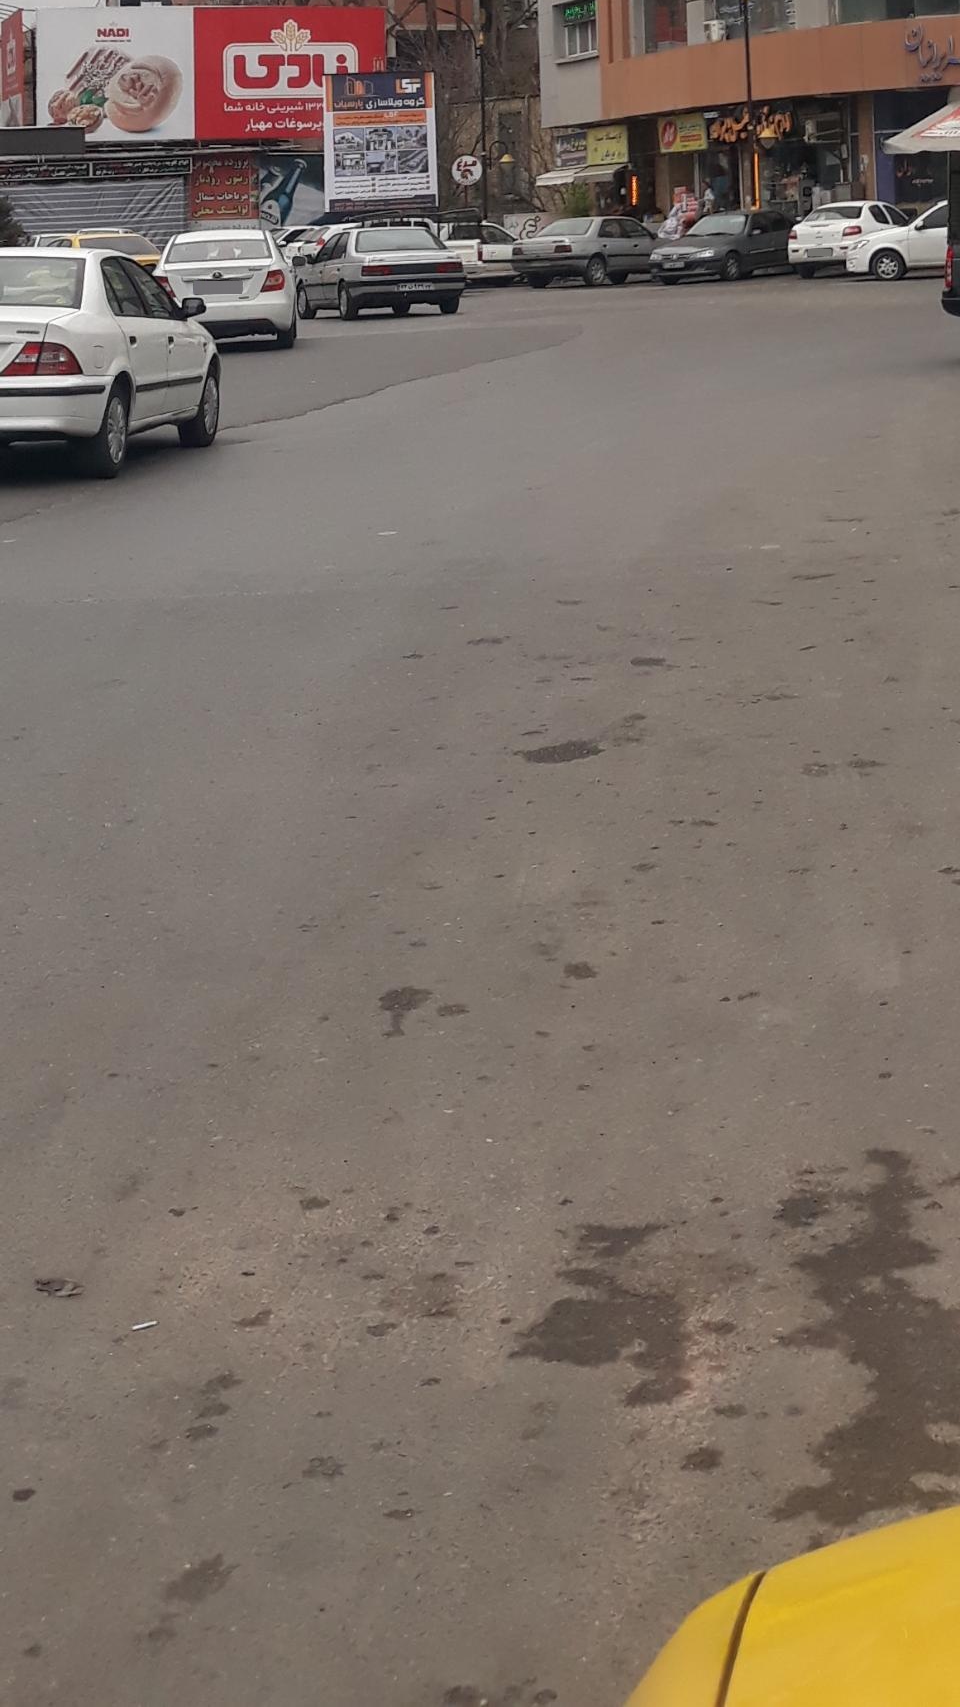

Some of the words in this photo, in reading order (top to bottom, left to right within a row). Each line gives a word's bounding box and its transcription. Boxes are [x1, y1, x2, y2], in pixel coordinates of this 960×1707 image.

[97, 28, 129, 38] NADI
[904, 24, 955, 83] ایرانیان
[223, 102, 244, 112] شما
[245, 102, 266, 112] خانه
[266, 102, 304, 114] شیرینی
[245, 118, 273, 133] مهیار
[456, 158, 478, 172] مرغ
[224, 175, 249, 185] زیتون
[194, 192, 215, 203] شمال
[192, 206, 214, 217] محلی
[216, 204, 249, 216] لواشک
